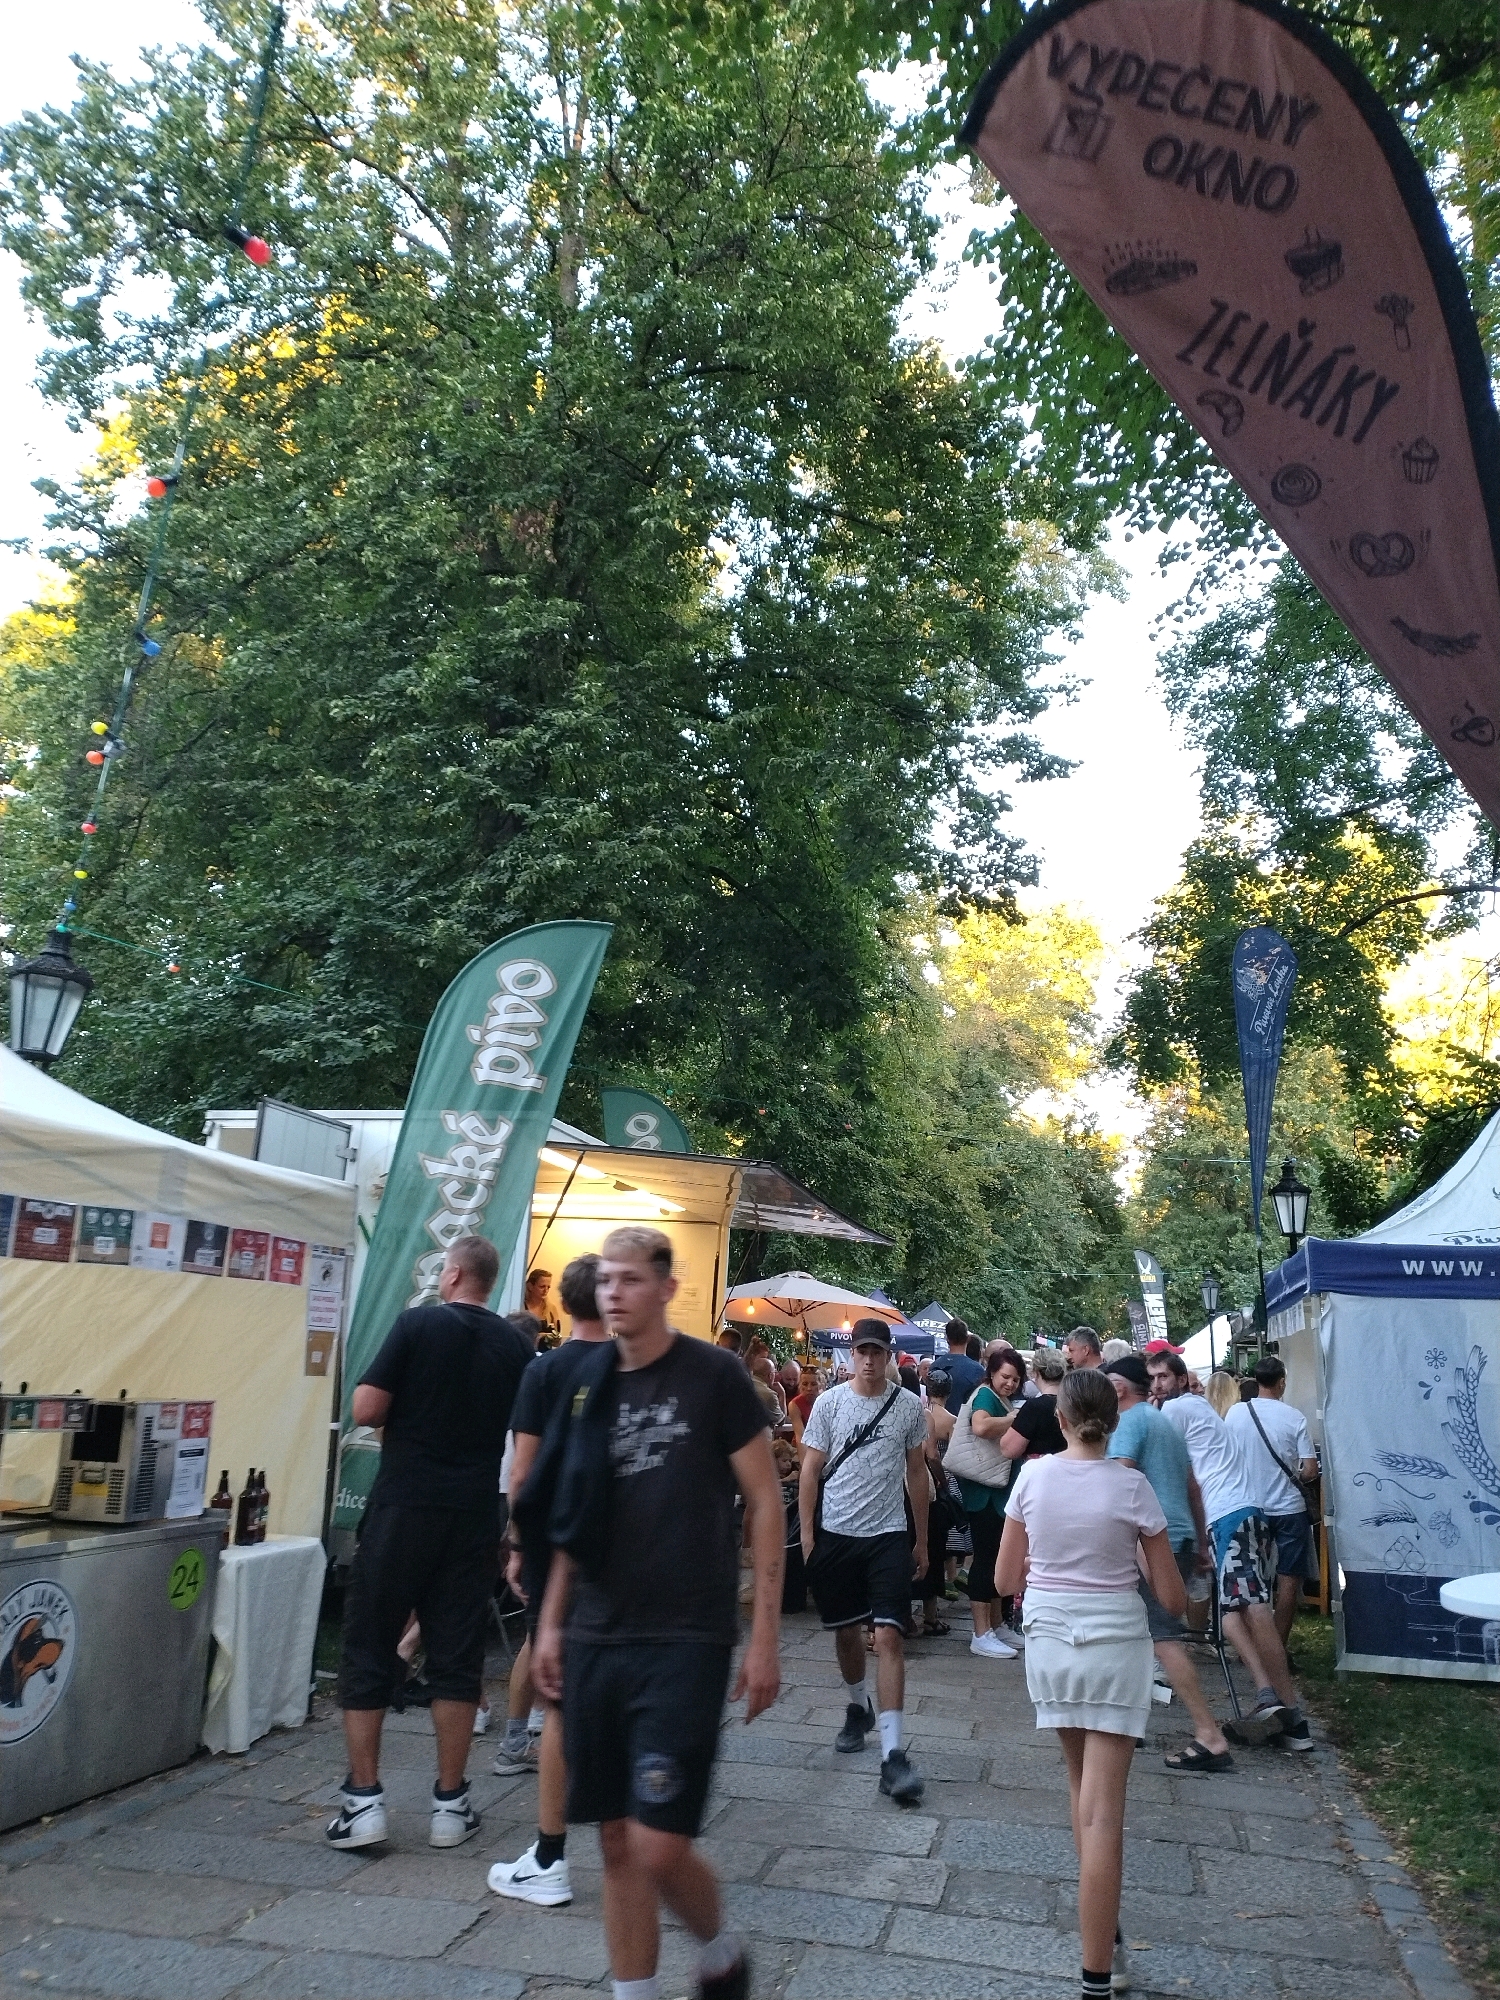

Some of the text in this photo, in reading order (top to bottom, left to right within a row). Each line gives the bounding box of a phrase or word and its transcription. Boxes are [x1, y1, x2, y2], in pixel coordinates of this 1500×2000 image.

[1142, 136, 1299, 215] OKNO
[1175, 297, 1400, 445] ZELŇÁKY
[466, 959, 557, 1094] pivo
[170, 1561, 199, 1599] 24
